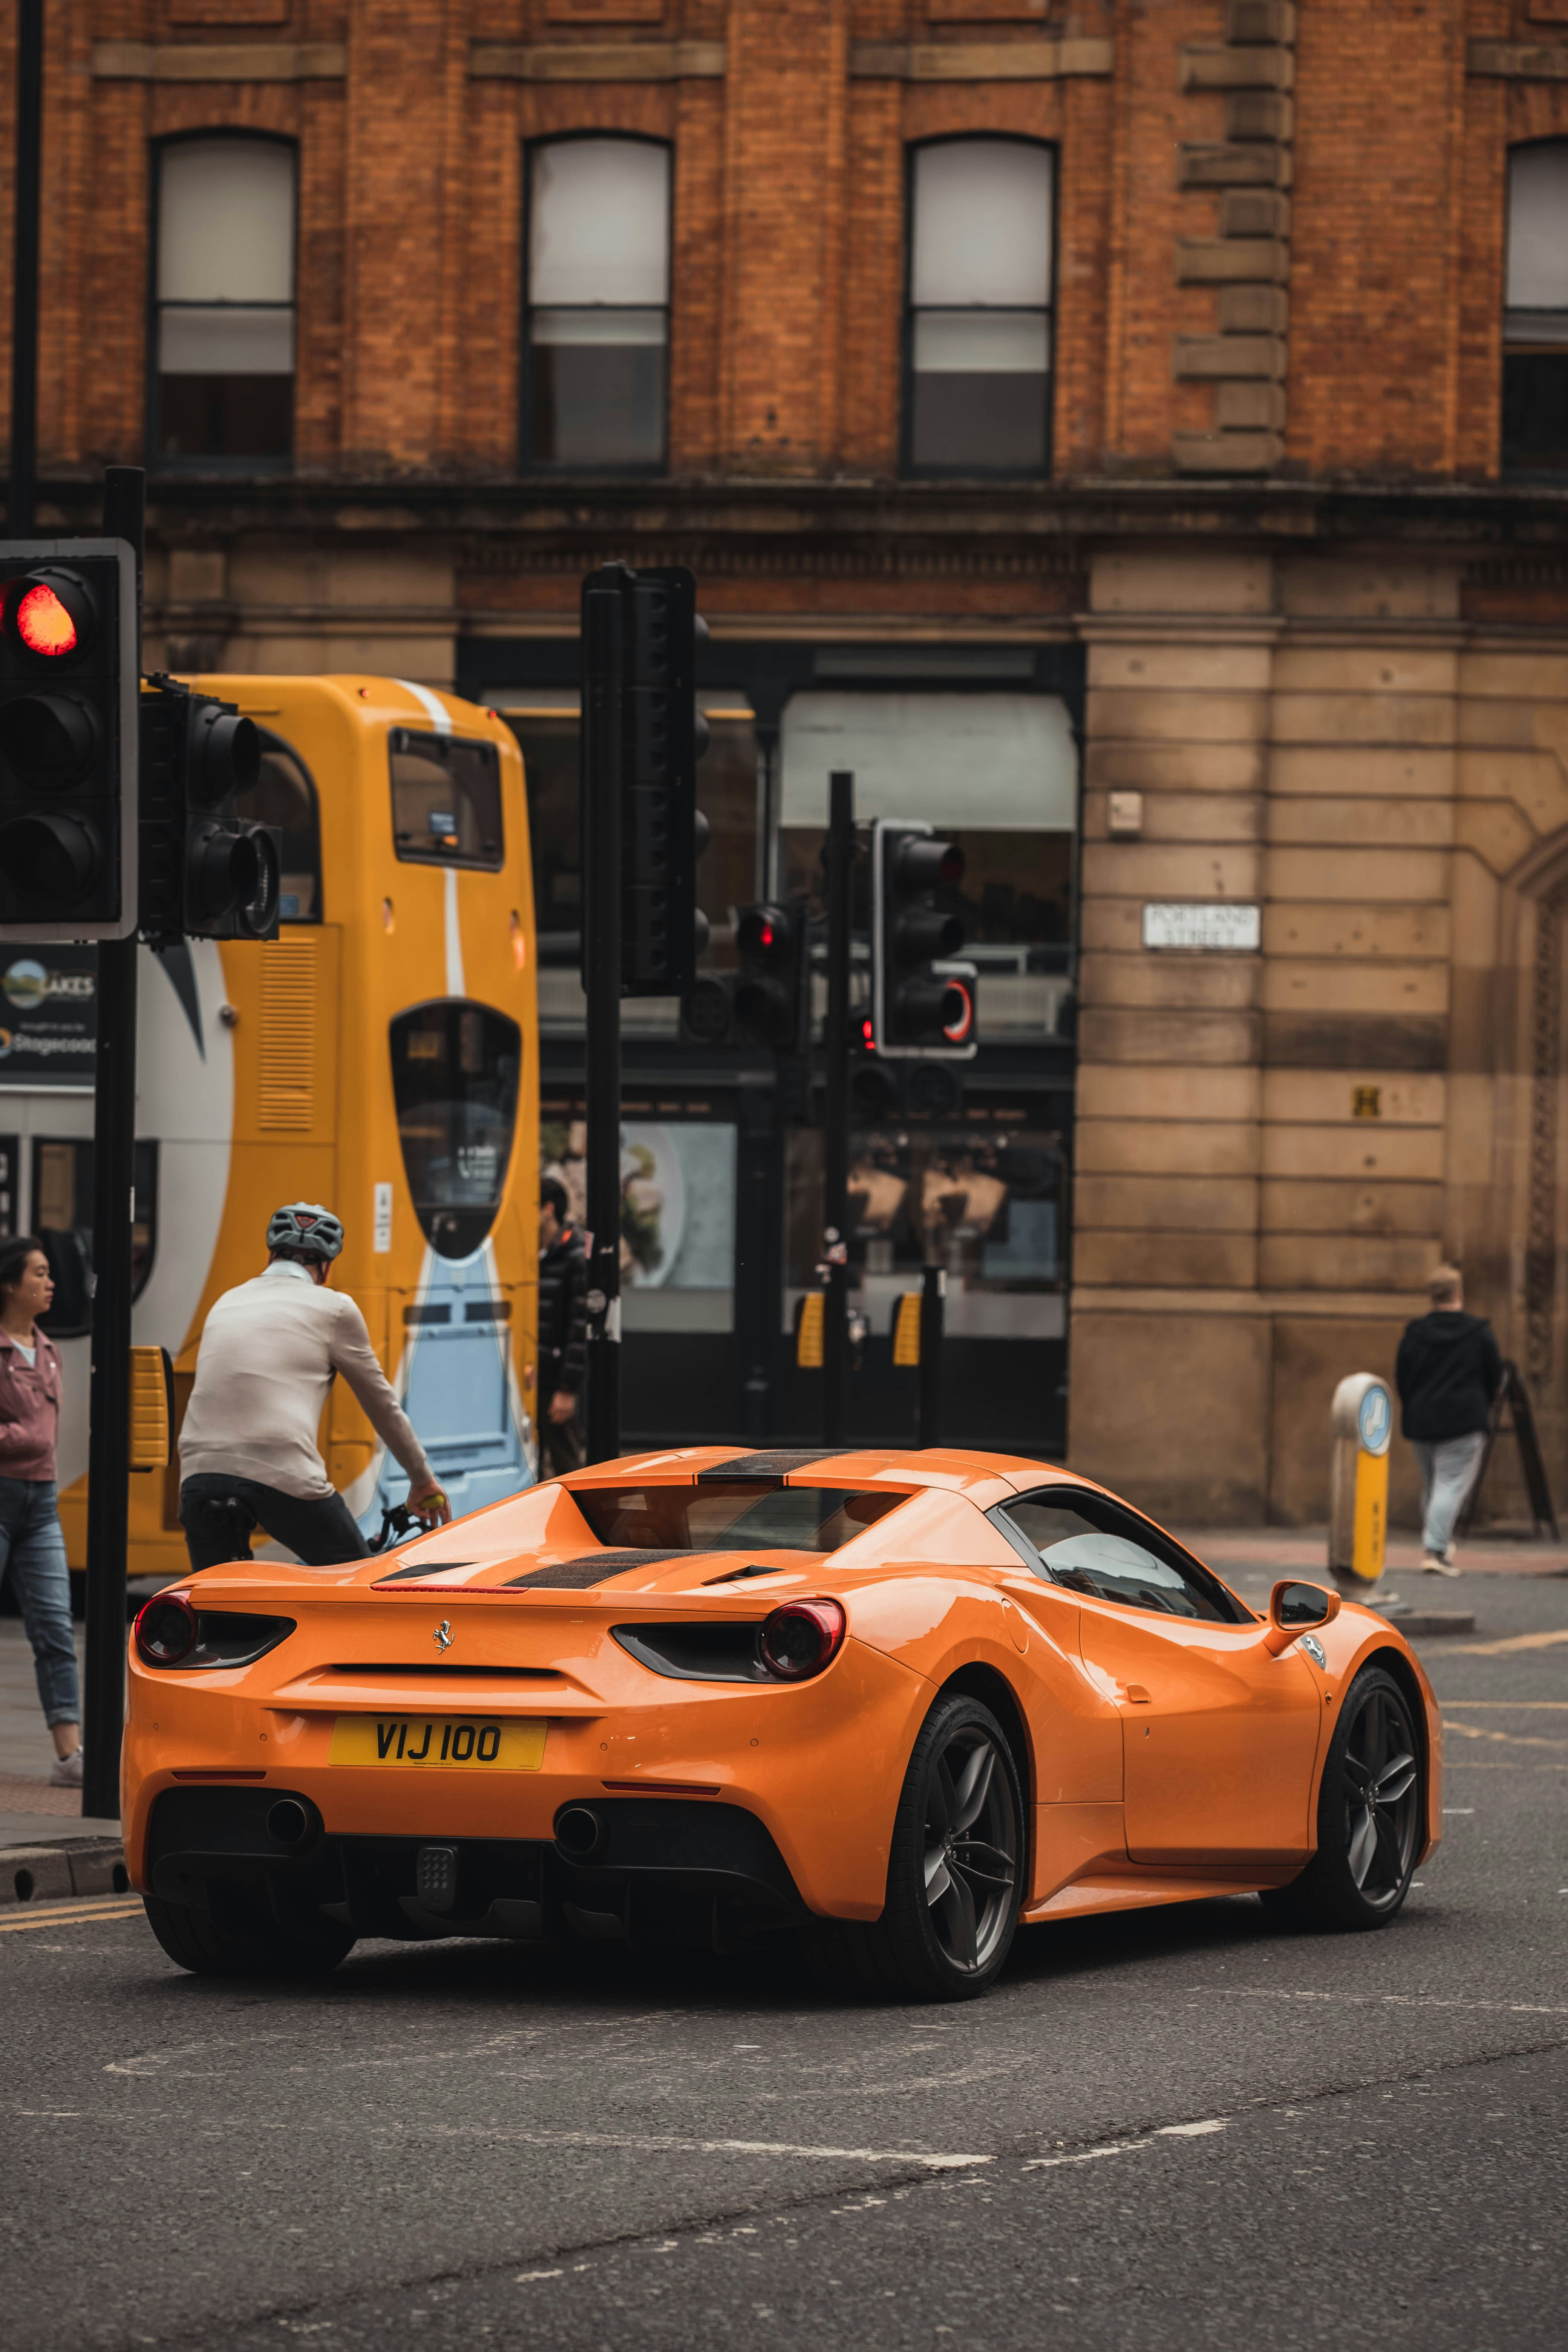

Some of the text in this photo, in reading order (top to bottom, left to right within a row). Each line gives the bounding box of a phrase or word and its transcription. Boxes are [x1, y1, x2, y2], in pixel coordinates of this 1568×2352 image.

[1165, 926, 1236, 946] STREET
[14, 1034, 96, 1056] Stagecoac
[377, 1724, 501, 1761] VIJ 100
